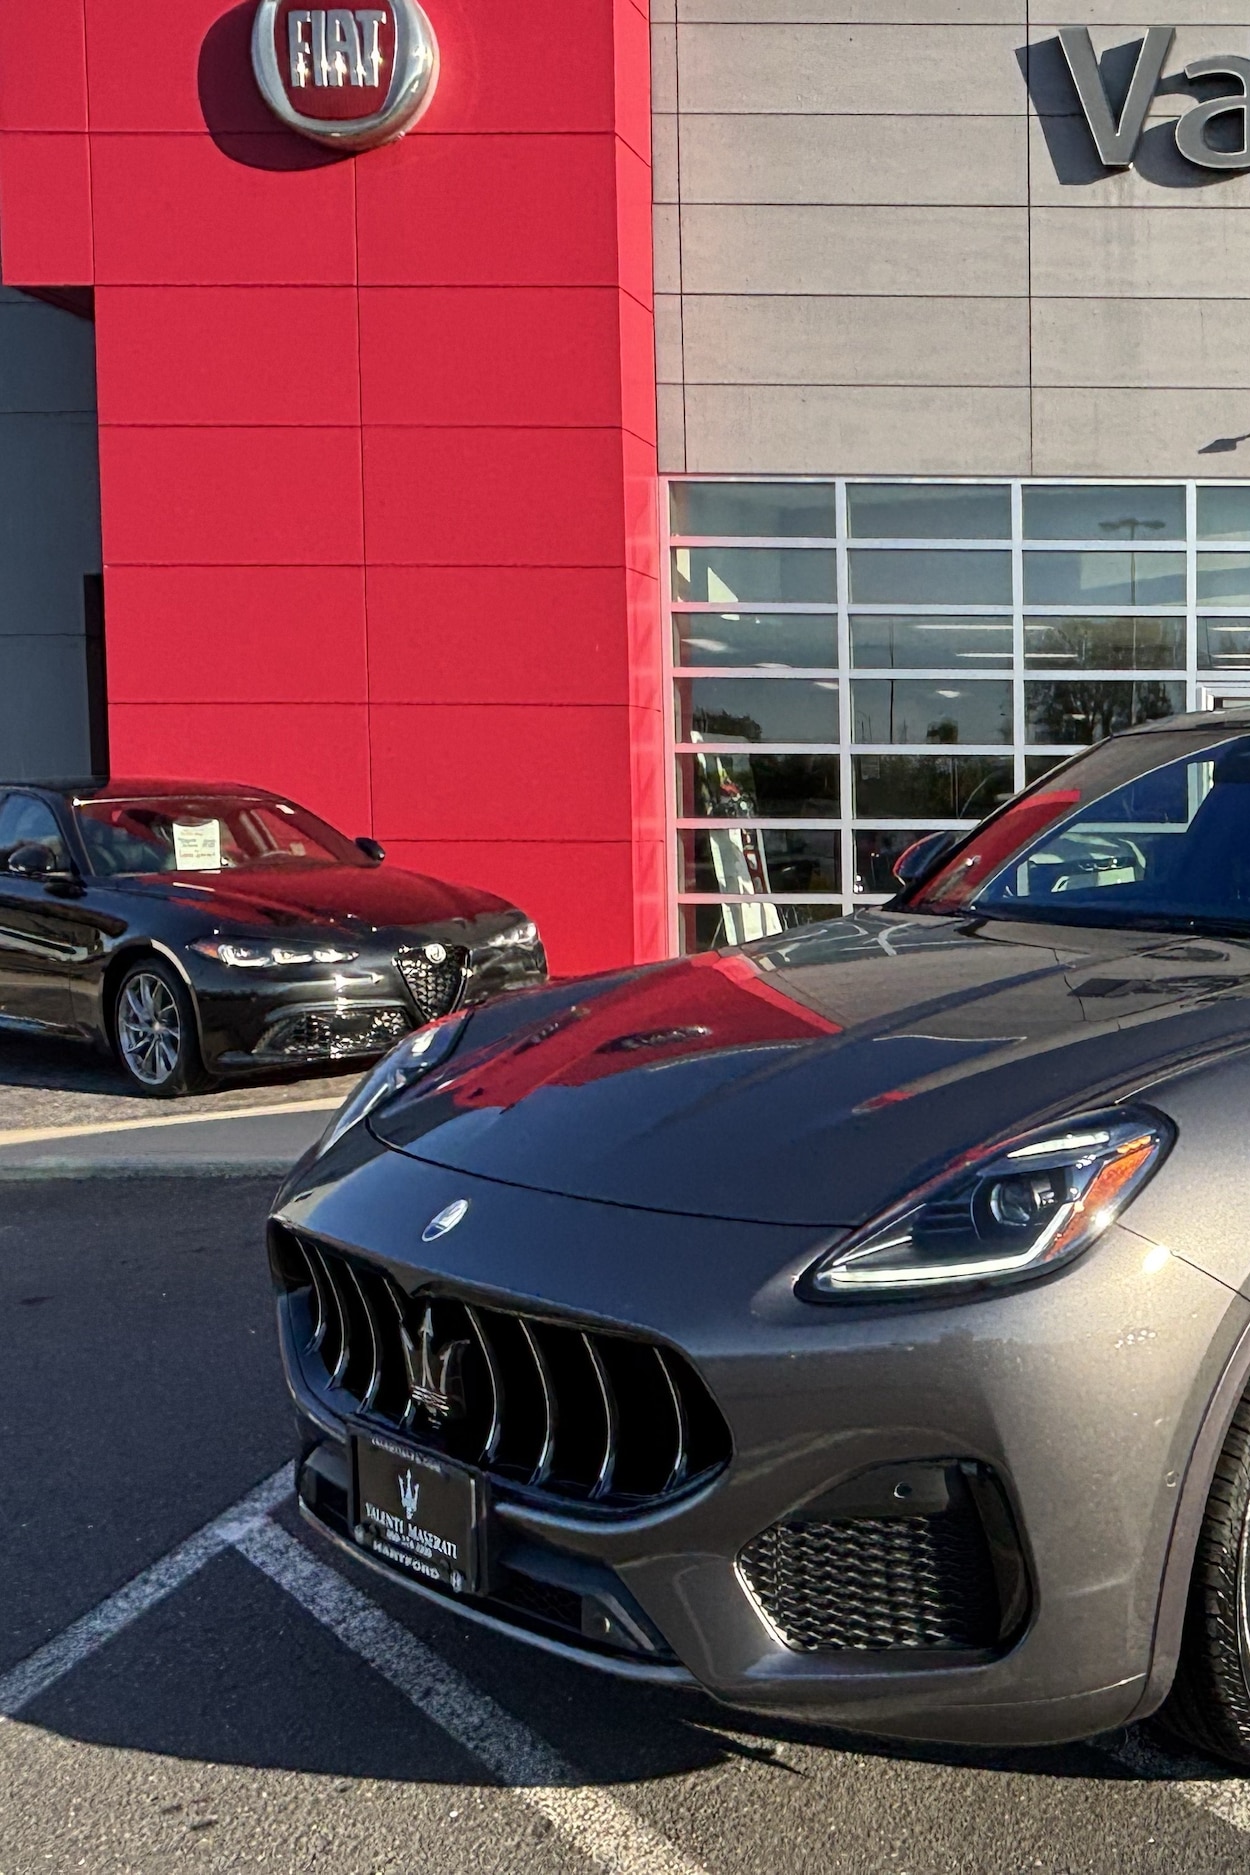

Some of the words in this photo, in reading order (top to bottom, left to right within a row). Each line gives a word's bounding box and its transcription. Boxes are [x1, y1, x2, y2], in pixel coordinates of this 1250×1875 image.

[287, 8, 387, 88] FIAT
[365, 1502, 404, 1534] VALENTI
[408, 1523, 457, 1560] MASERATI
